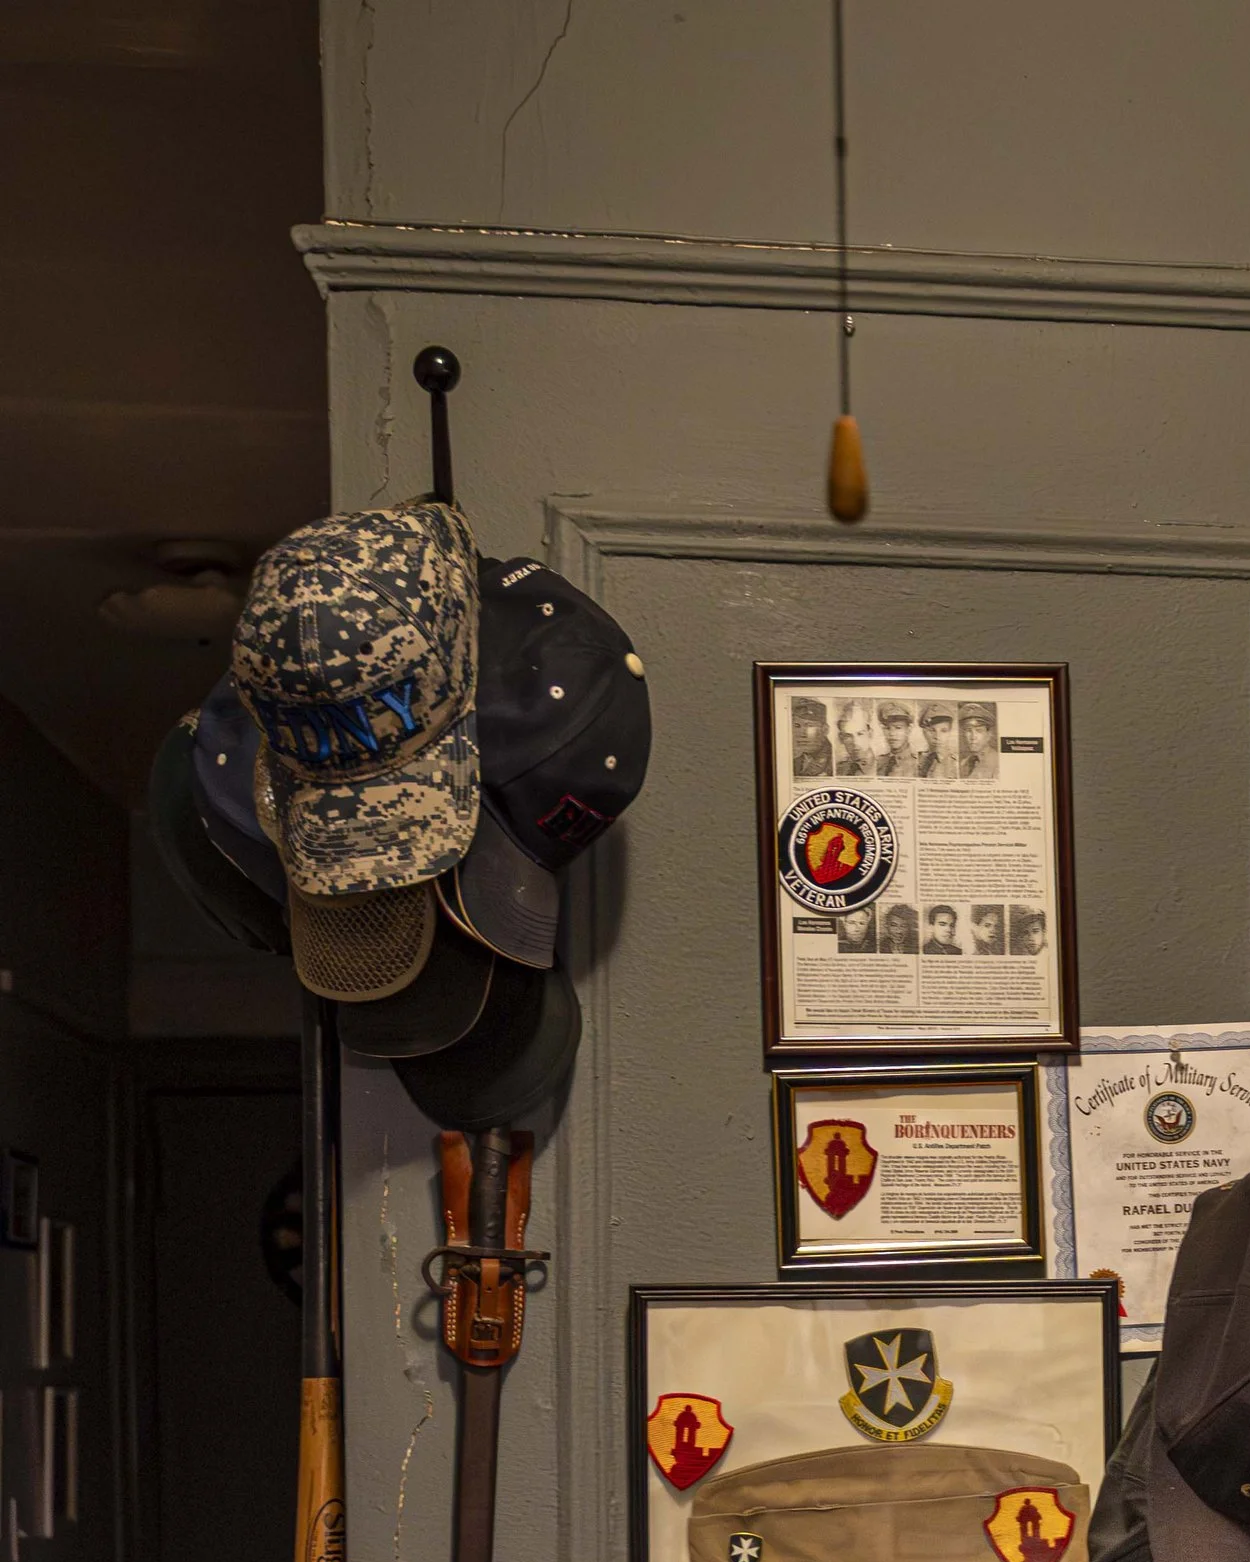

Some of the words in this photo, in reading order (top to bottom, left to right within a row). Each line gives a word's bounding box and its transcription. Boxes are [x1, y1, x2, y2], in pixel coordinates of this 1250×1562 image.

[788, 792, 830, 820] UNITED
[835, 792, 881, 822] STATES
[877, 826, 893, 863] ARMY
[810, 809, 863, 825] INFANTRY
[858, 823, 875, 876] REGIMENT
[785, 870, 846, 907] VETERAN
[1075, 1074, 1135, 1116] Certificate
[1139, 1065, 1151, 1093] of
[1155, 1063, 1217, 1096] Military
[895, 1121, 1015, 1139] BORINQUENEERS
[900, 1115, 916, 1123] THE
[1116, 1162, 1156, 1171] UNITED
[1160, 1160, 1199, 1169] STATES
[1203, 1159, 1231, 1167] NAVY
[1123, 1204, 1171, 1215] RAFAEL
[851, 1414, 882, 1438] HONOR
[886, 1432, 899, 1440] ET
[904, 1404, 946, 1439] FIDELITAS
